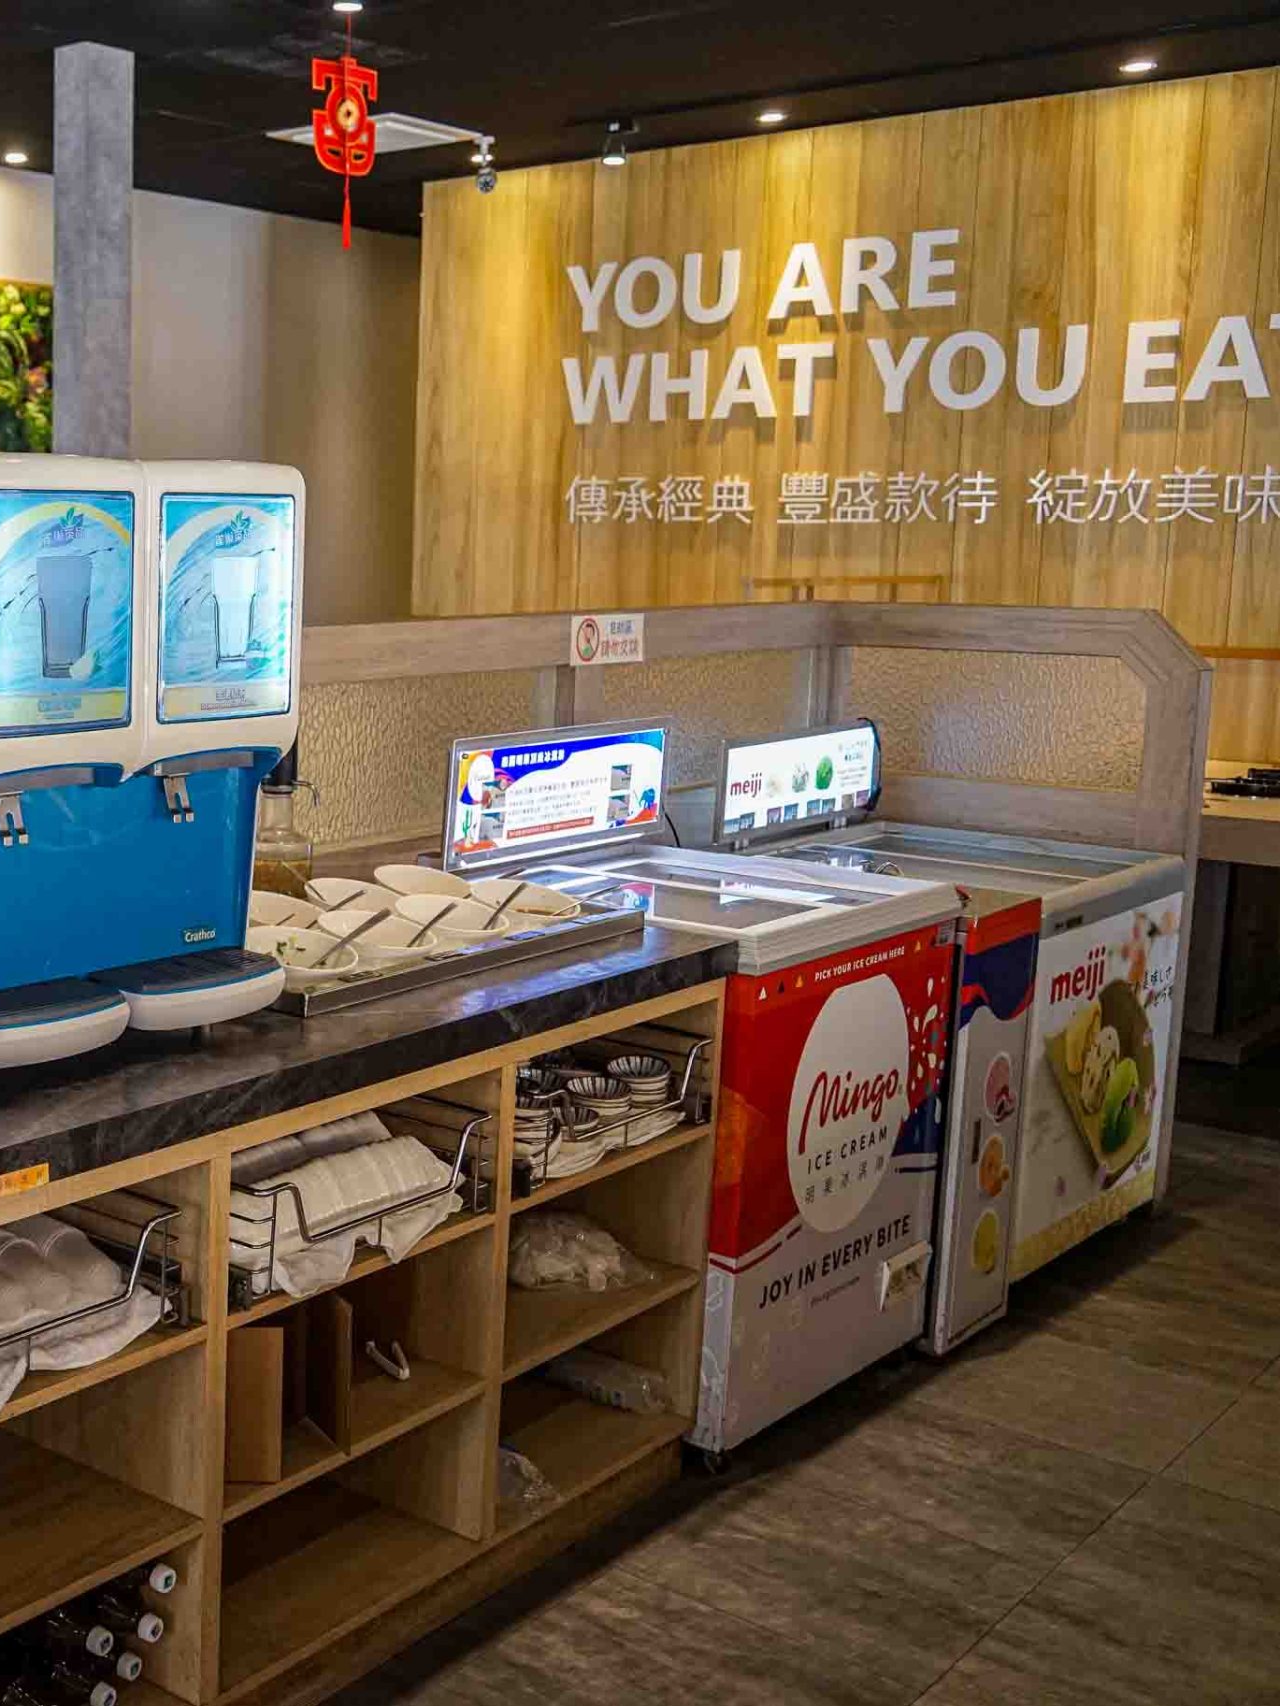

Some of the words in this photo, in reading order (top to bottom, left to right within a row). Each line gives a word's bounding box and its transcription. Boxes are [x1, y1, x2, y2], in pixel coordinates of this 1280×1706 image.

[567, 250, 741, 332] YOU
[767, 228, 960, 320] ARE
[562, 342, 835, 425] WHAT
[866, 323, 1089, 413] YOU
[1122, 315, 1280, 404] EA
[565, 472, 755, 525] 傳承經典
[776, 470, 999, 525] 豐盛款待
[1026, 465, 1280, 525] 綻放美味
[730, 772, 762, 799] meiji
[814, 968, 832, 982] PICK
[833, 961, 852, 977] YOUR
[888, 945, 905, 959] HERE
[1050, 944, 1106, 1005] meiji
[807, 1150, 832, 1175] ICE
[840, 1126, 888, 1159] CREAM
[759, 1273, 793, 1309] JOY
[798, 1261, 817, 1289] IN
[821, 1233, 873, 1277] EVERY
[877, 1214, 911, 1248] BITE
